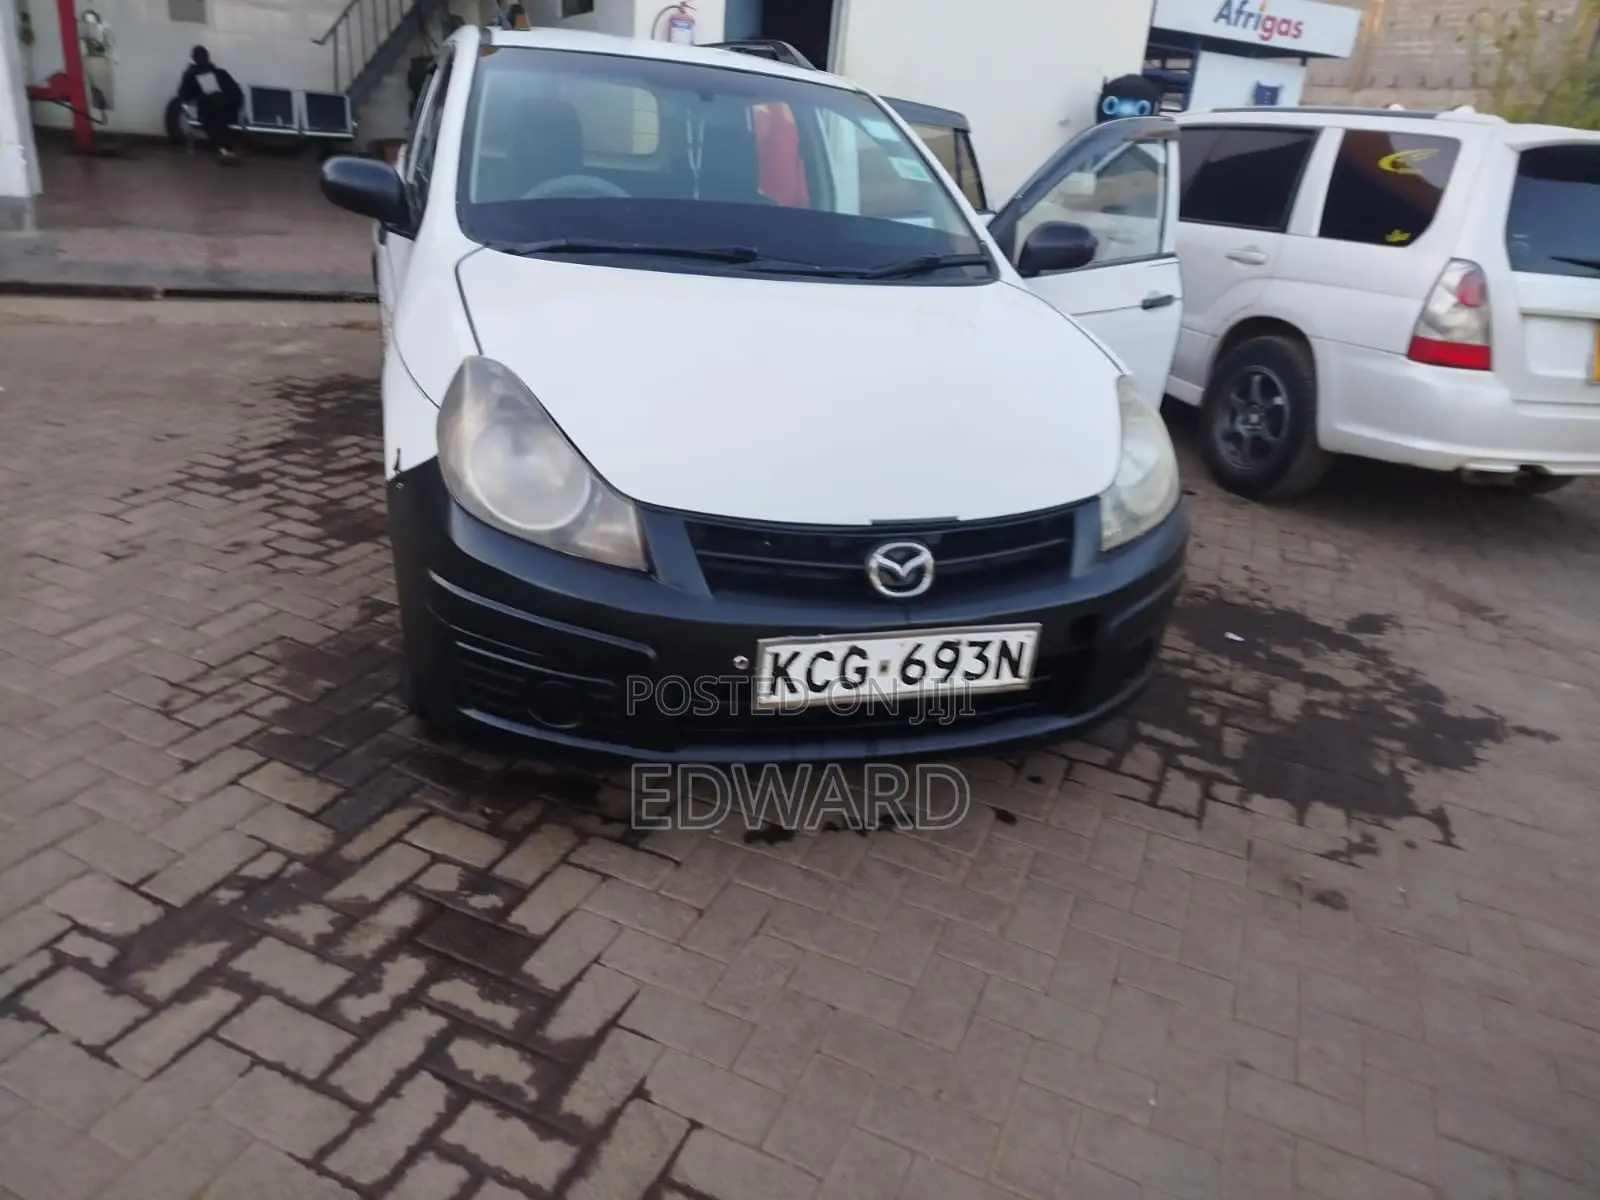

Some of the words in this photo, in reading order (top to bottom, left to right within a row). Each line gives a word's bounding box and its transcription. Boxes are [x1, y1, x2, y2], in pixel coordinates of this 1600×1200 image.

[1213, 0, 1304, 41] Afrigas
[770, 645, 869, 695] KCG
[900, 640, 1026, 686] 693N
